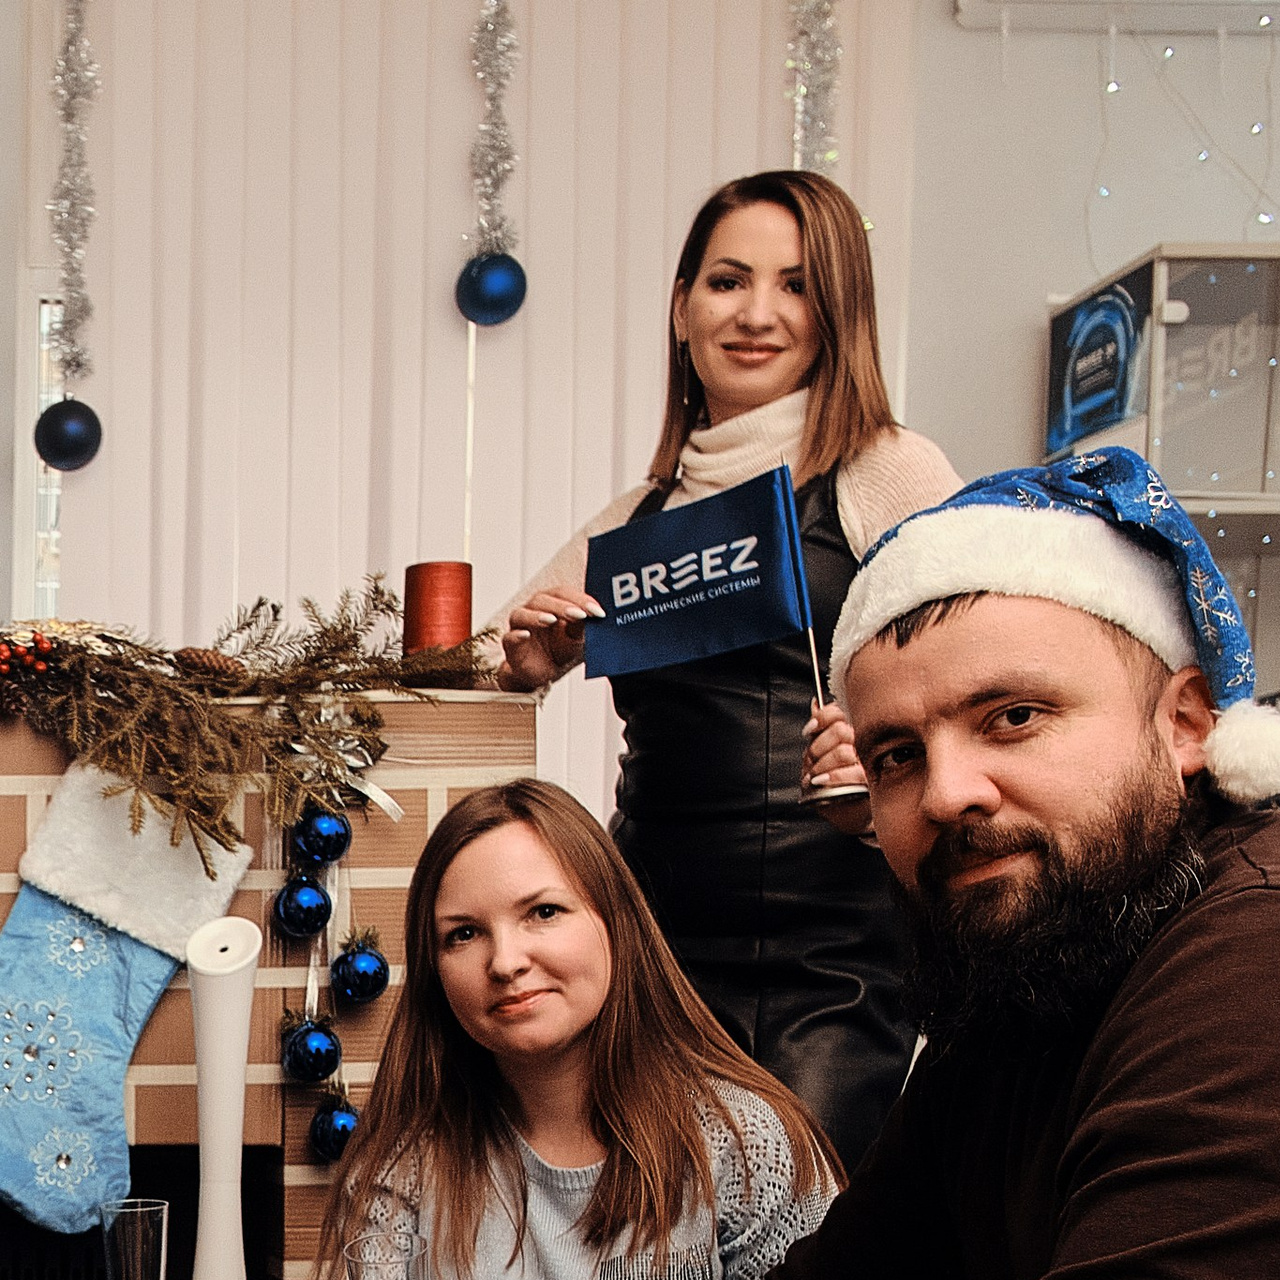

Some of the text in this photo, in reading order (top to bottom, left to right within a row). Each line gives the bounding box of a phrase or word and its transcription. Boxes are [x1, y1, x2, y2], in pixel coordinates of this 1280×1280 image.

[612, 535, 759, 608] BREEZ
[616, 574, 761, 625] КЛИМАТИЧЕСКИЕ СИСТЕМЫ
